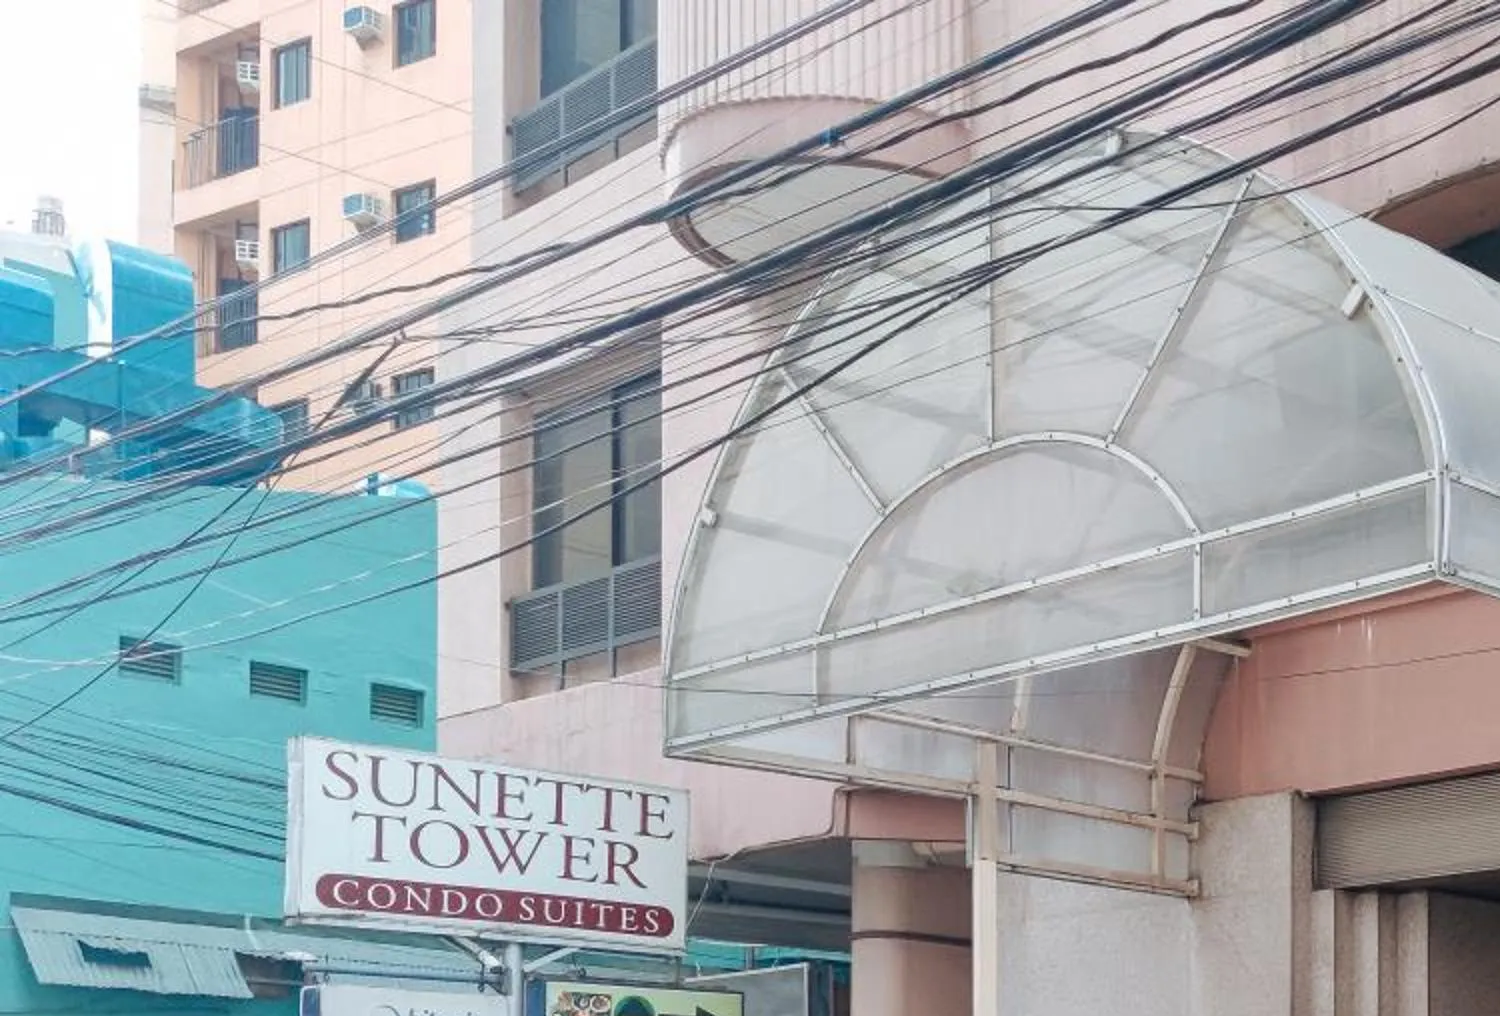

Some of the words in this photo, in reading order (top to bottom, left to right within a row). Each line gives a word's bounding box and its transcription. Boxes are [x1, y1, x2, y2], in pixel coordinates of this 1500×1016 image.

[321, 749, 674, 840] SUNETTE
[351, 810, 648, 889] TOWER
[332, 879, 504, 919] CONDO
[518, 897, 660, 934] SUITES
